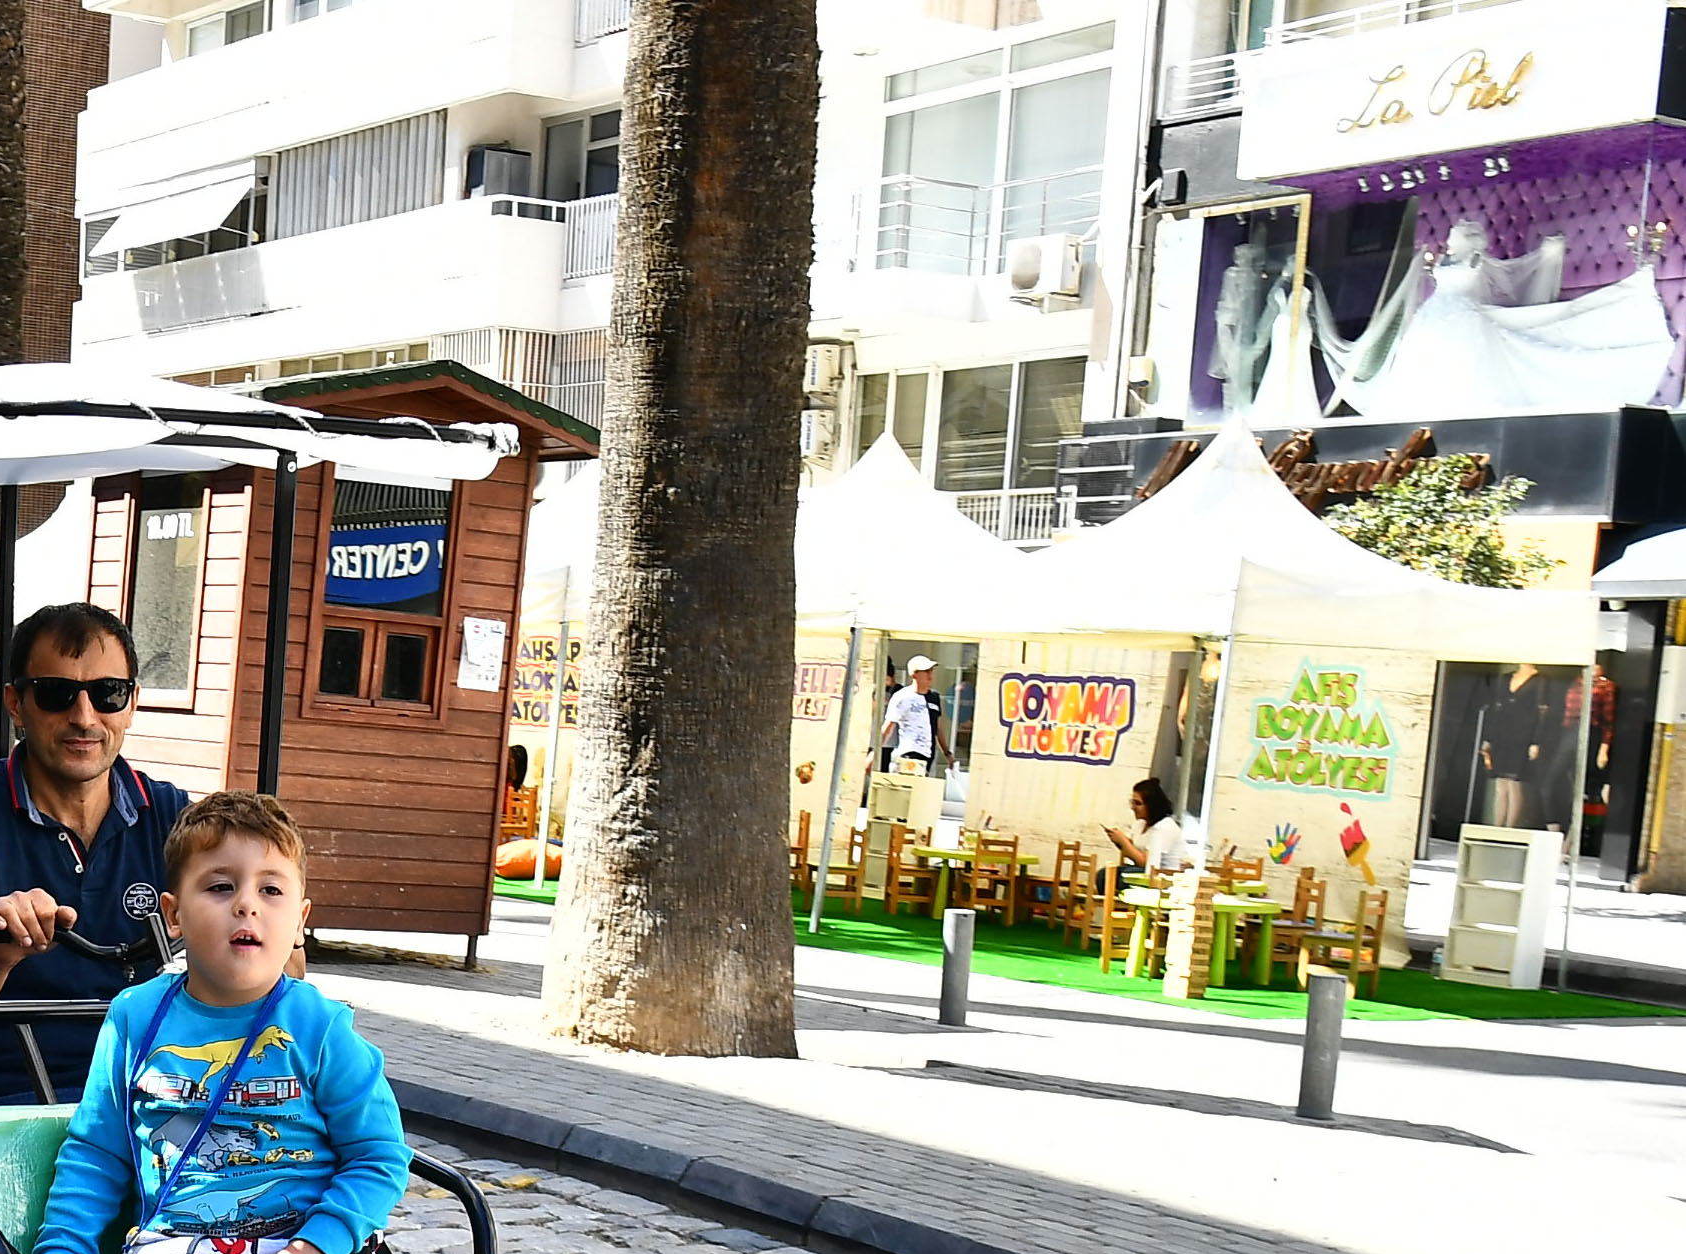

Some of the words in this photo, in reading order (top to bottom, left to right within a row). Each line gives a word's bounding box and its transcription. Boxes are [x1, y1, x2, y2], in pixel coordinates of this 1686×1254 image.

[1336, 65, 1414, 133] La
[1428, 49, 1534, 116] Piel
[1002, 680, 1128, 728] BOYAMA
[1255, 703, 1391, 749] BOYAMA
